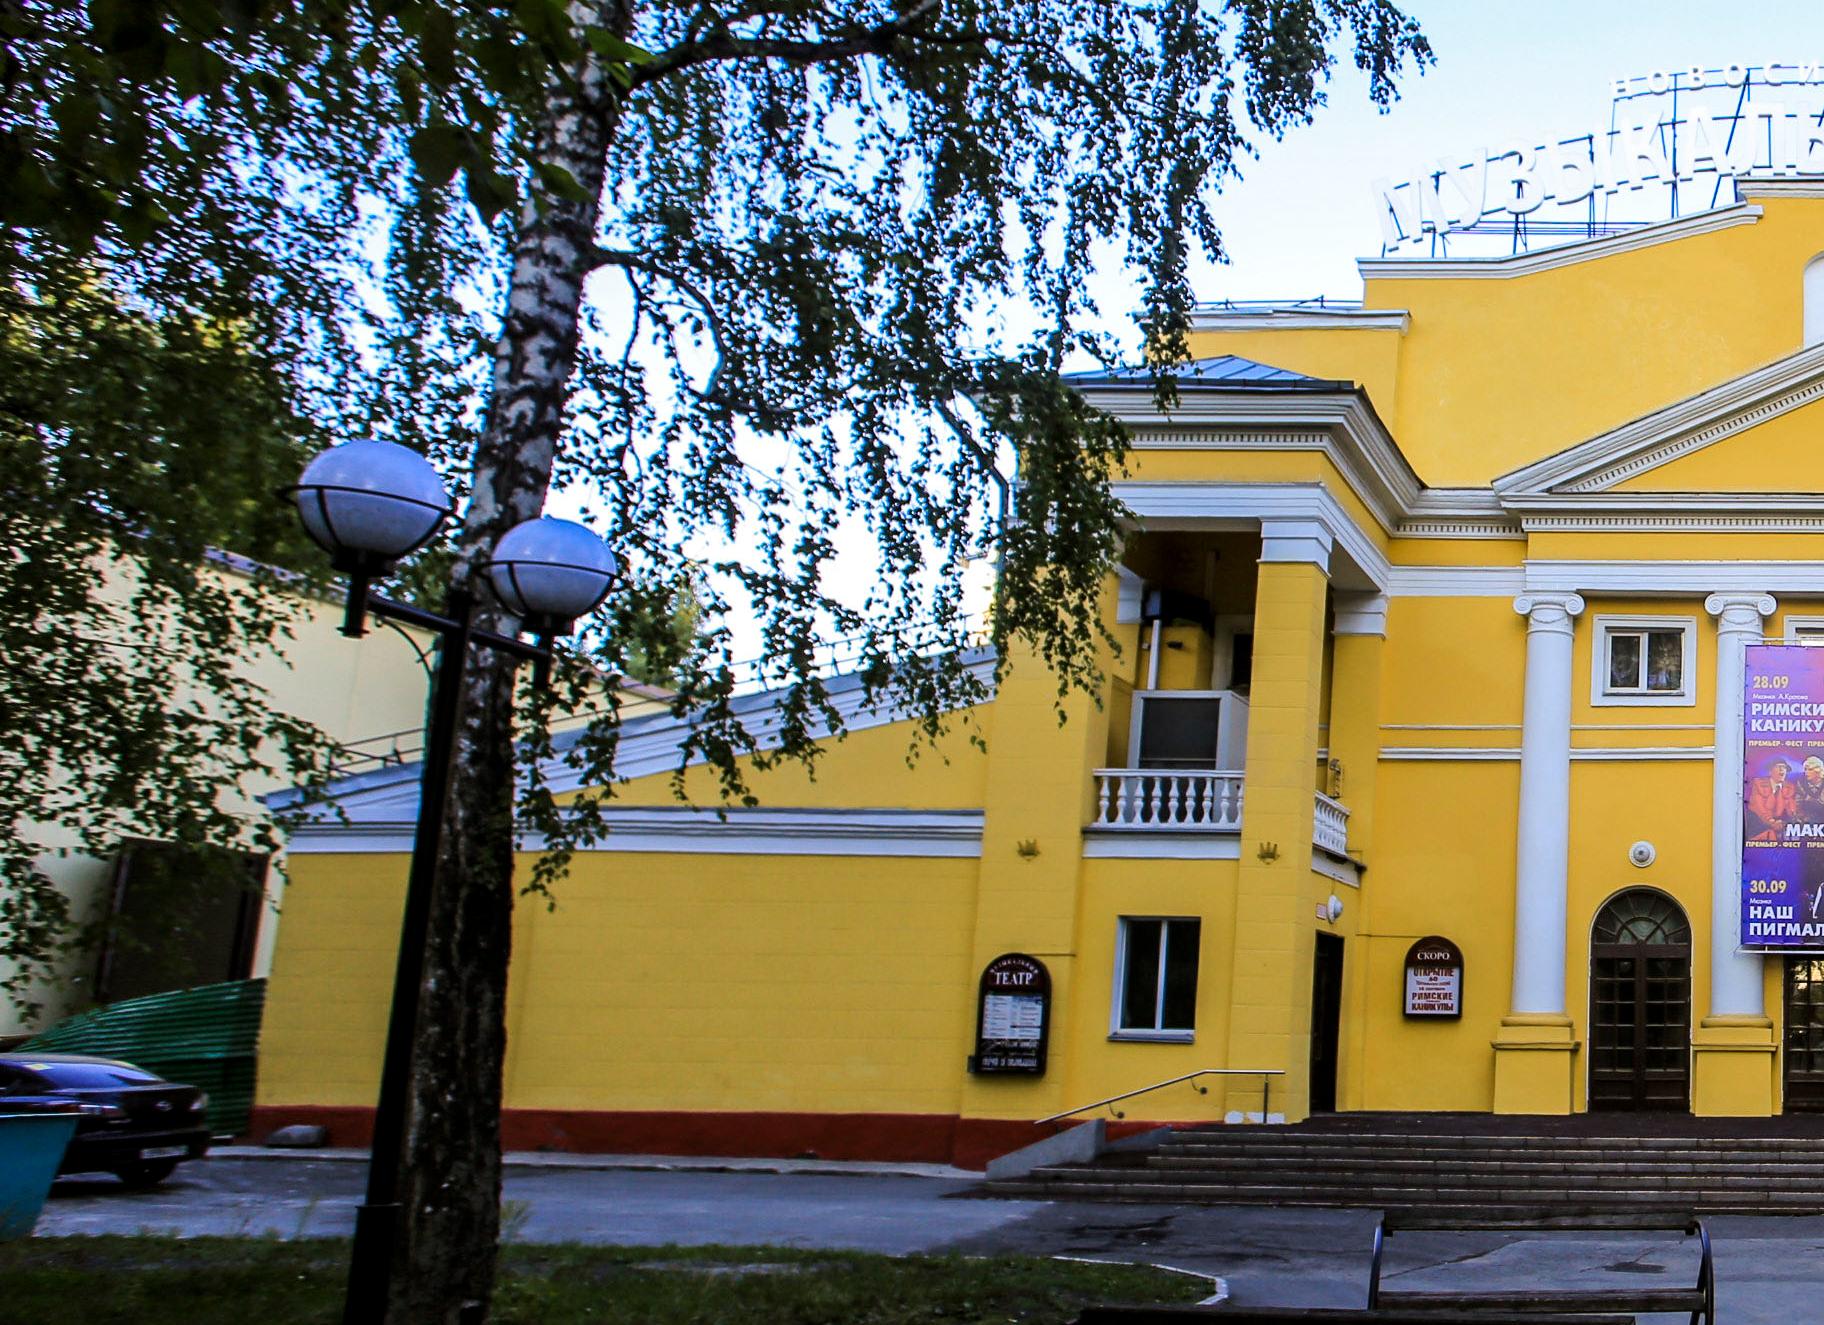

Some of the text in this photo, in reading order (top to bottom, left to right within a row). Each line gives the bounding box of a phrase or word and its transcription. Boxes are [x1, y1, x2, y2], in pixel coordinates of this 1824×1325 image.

[1753, 676, 1789, 689] 28.09
[1750, 880, 1787, 893] 30.09
[1750, 907, 1793, 919] НАШ
[1417, 952, 1450, 960] СКОРО
[995, 972, 1033, 985] ТЕАТР
[1412, 992, 1453, 1000] РИМСКИЕ
